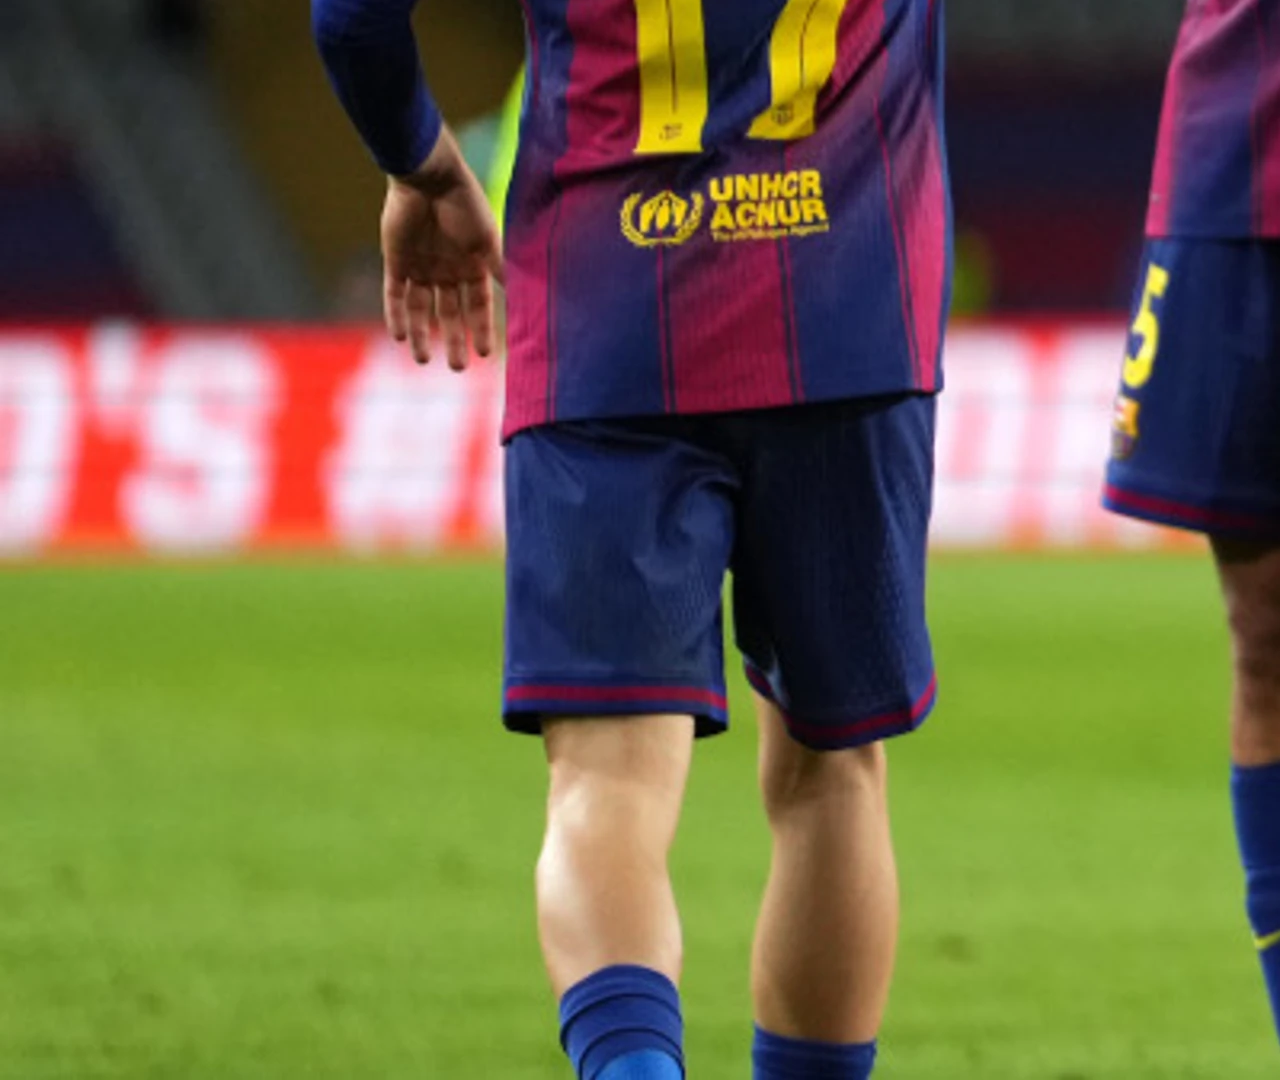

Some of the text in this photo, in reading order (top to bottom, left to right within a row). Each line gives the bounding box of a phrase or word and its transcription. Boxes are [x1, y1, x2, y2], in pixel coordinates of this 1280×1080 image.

[709, 169, 823, 201] UNHCR
[710, 199, 828, 230] ACNUR
[1122, 261, 1169, 388] 5
